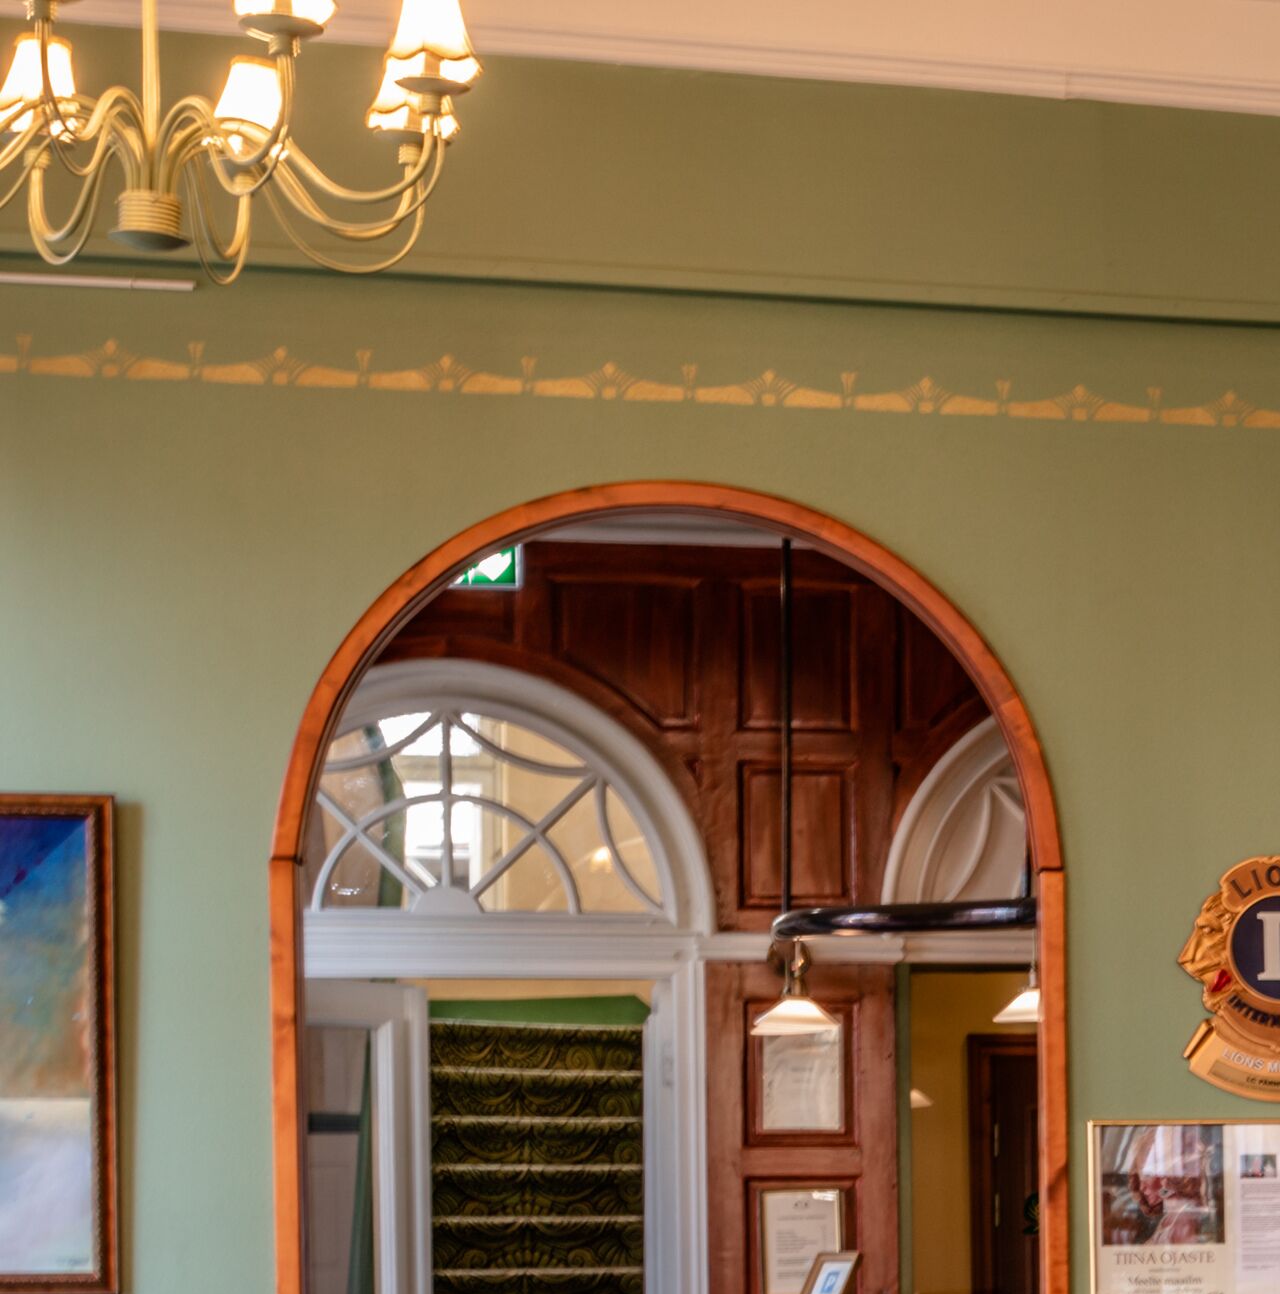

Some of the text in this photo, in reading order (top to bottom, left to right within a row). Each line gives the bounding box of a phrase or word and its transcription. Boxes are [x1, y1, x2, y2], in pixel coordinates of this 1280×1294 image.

[1222, 1047, 1265, 1072] LIONS
[1113, 1249, 1216, 1267] TIINA OJASTE
